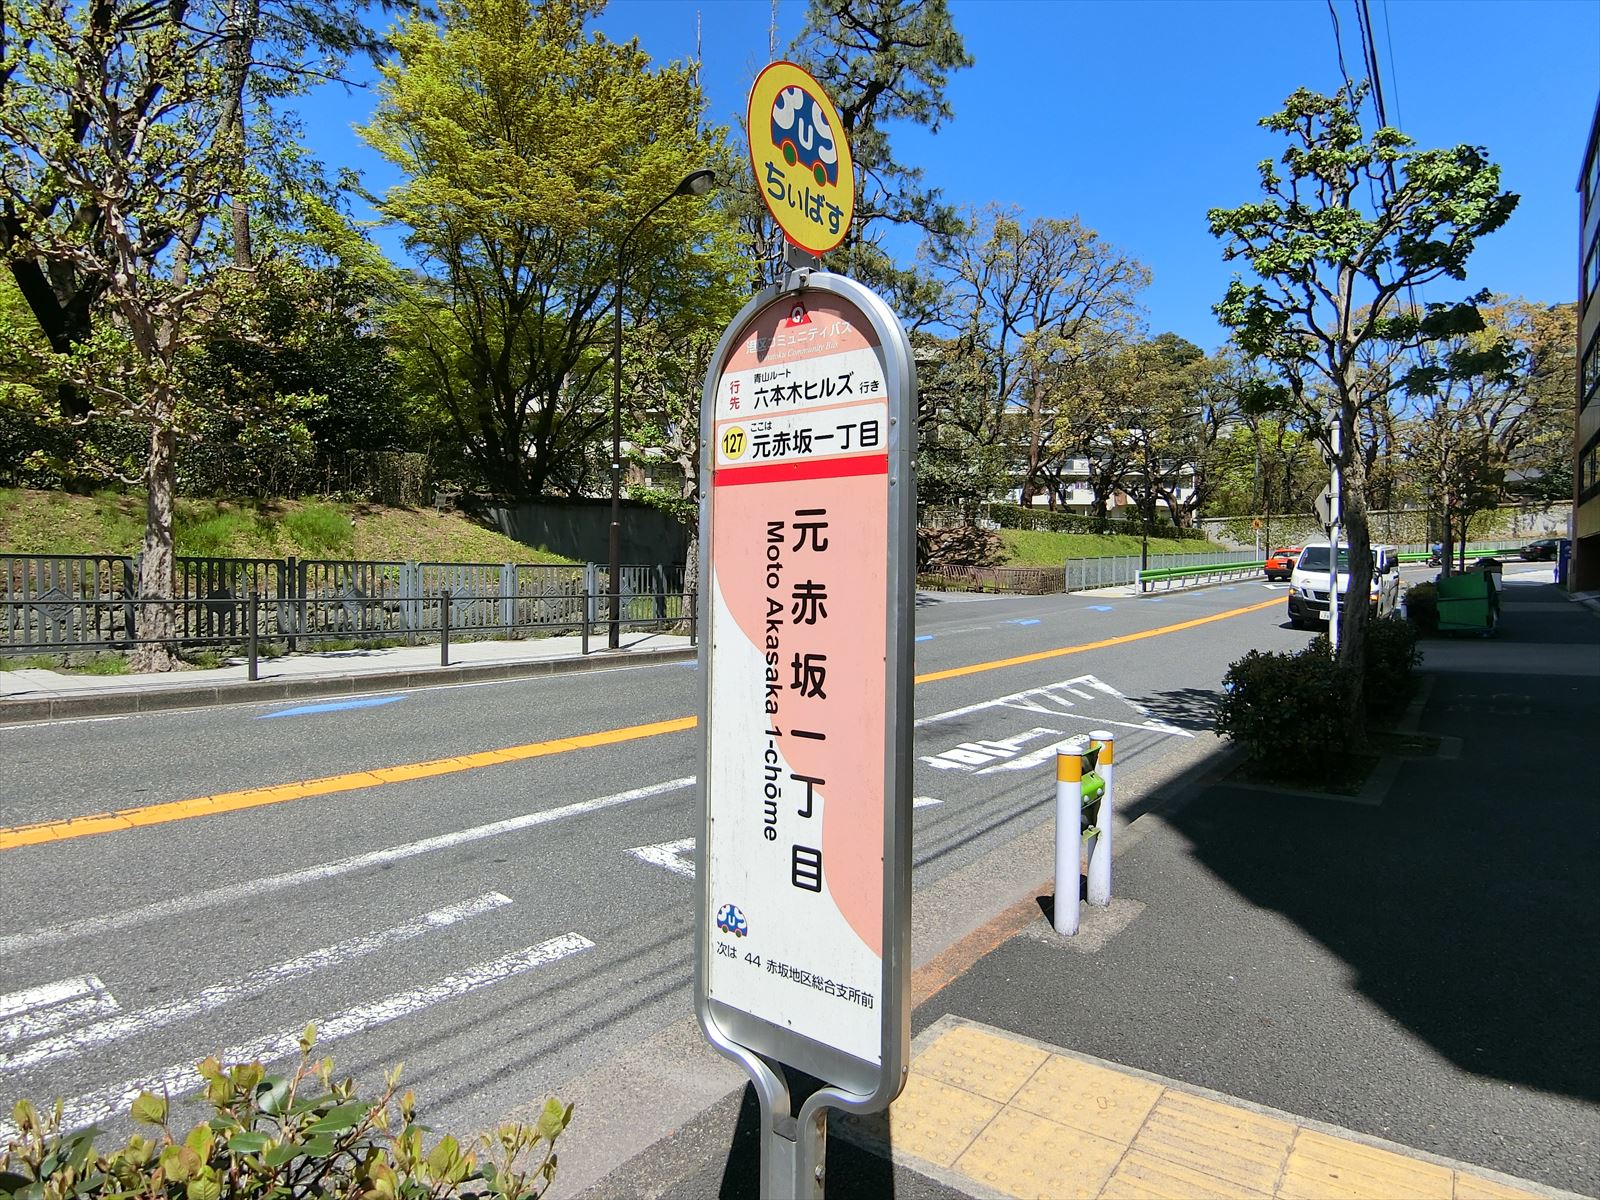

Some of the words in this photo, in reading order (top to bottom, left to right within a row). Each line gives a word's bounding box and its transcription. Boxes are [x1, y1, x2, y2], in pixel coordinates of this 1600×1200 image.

[765, 161, 844, 235] ちいばす
[729, 380, 741, 411] 行先
[754, 368, 791, 384] 青山ルート
[754, 371, 855, 410] 六本木ヒルズ
[859, 380, 880, 394] 行き
[723, 433, 744, 454] 127
[750, 421, 773, 432] ここは
[752, 419, 879, 459] 元赤坂一丁目
[766, 521, 785, 589] Moto
[765, 597, 784, 714] Akasaka
[790, 508, 829, 893] 元赤坂一丁目
[716, 941, 737, 959] 次は
[744, 952, 762, 968] 44
[766, 959, 874, 1009] 赤坂地区総合支所前
